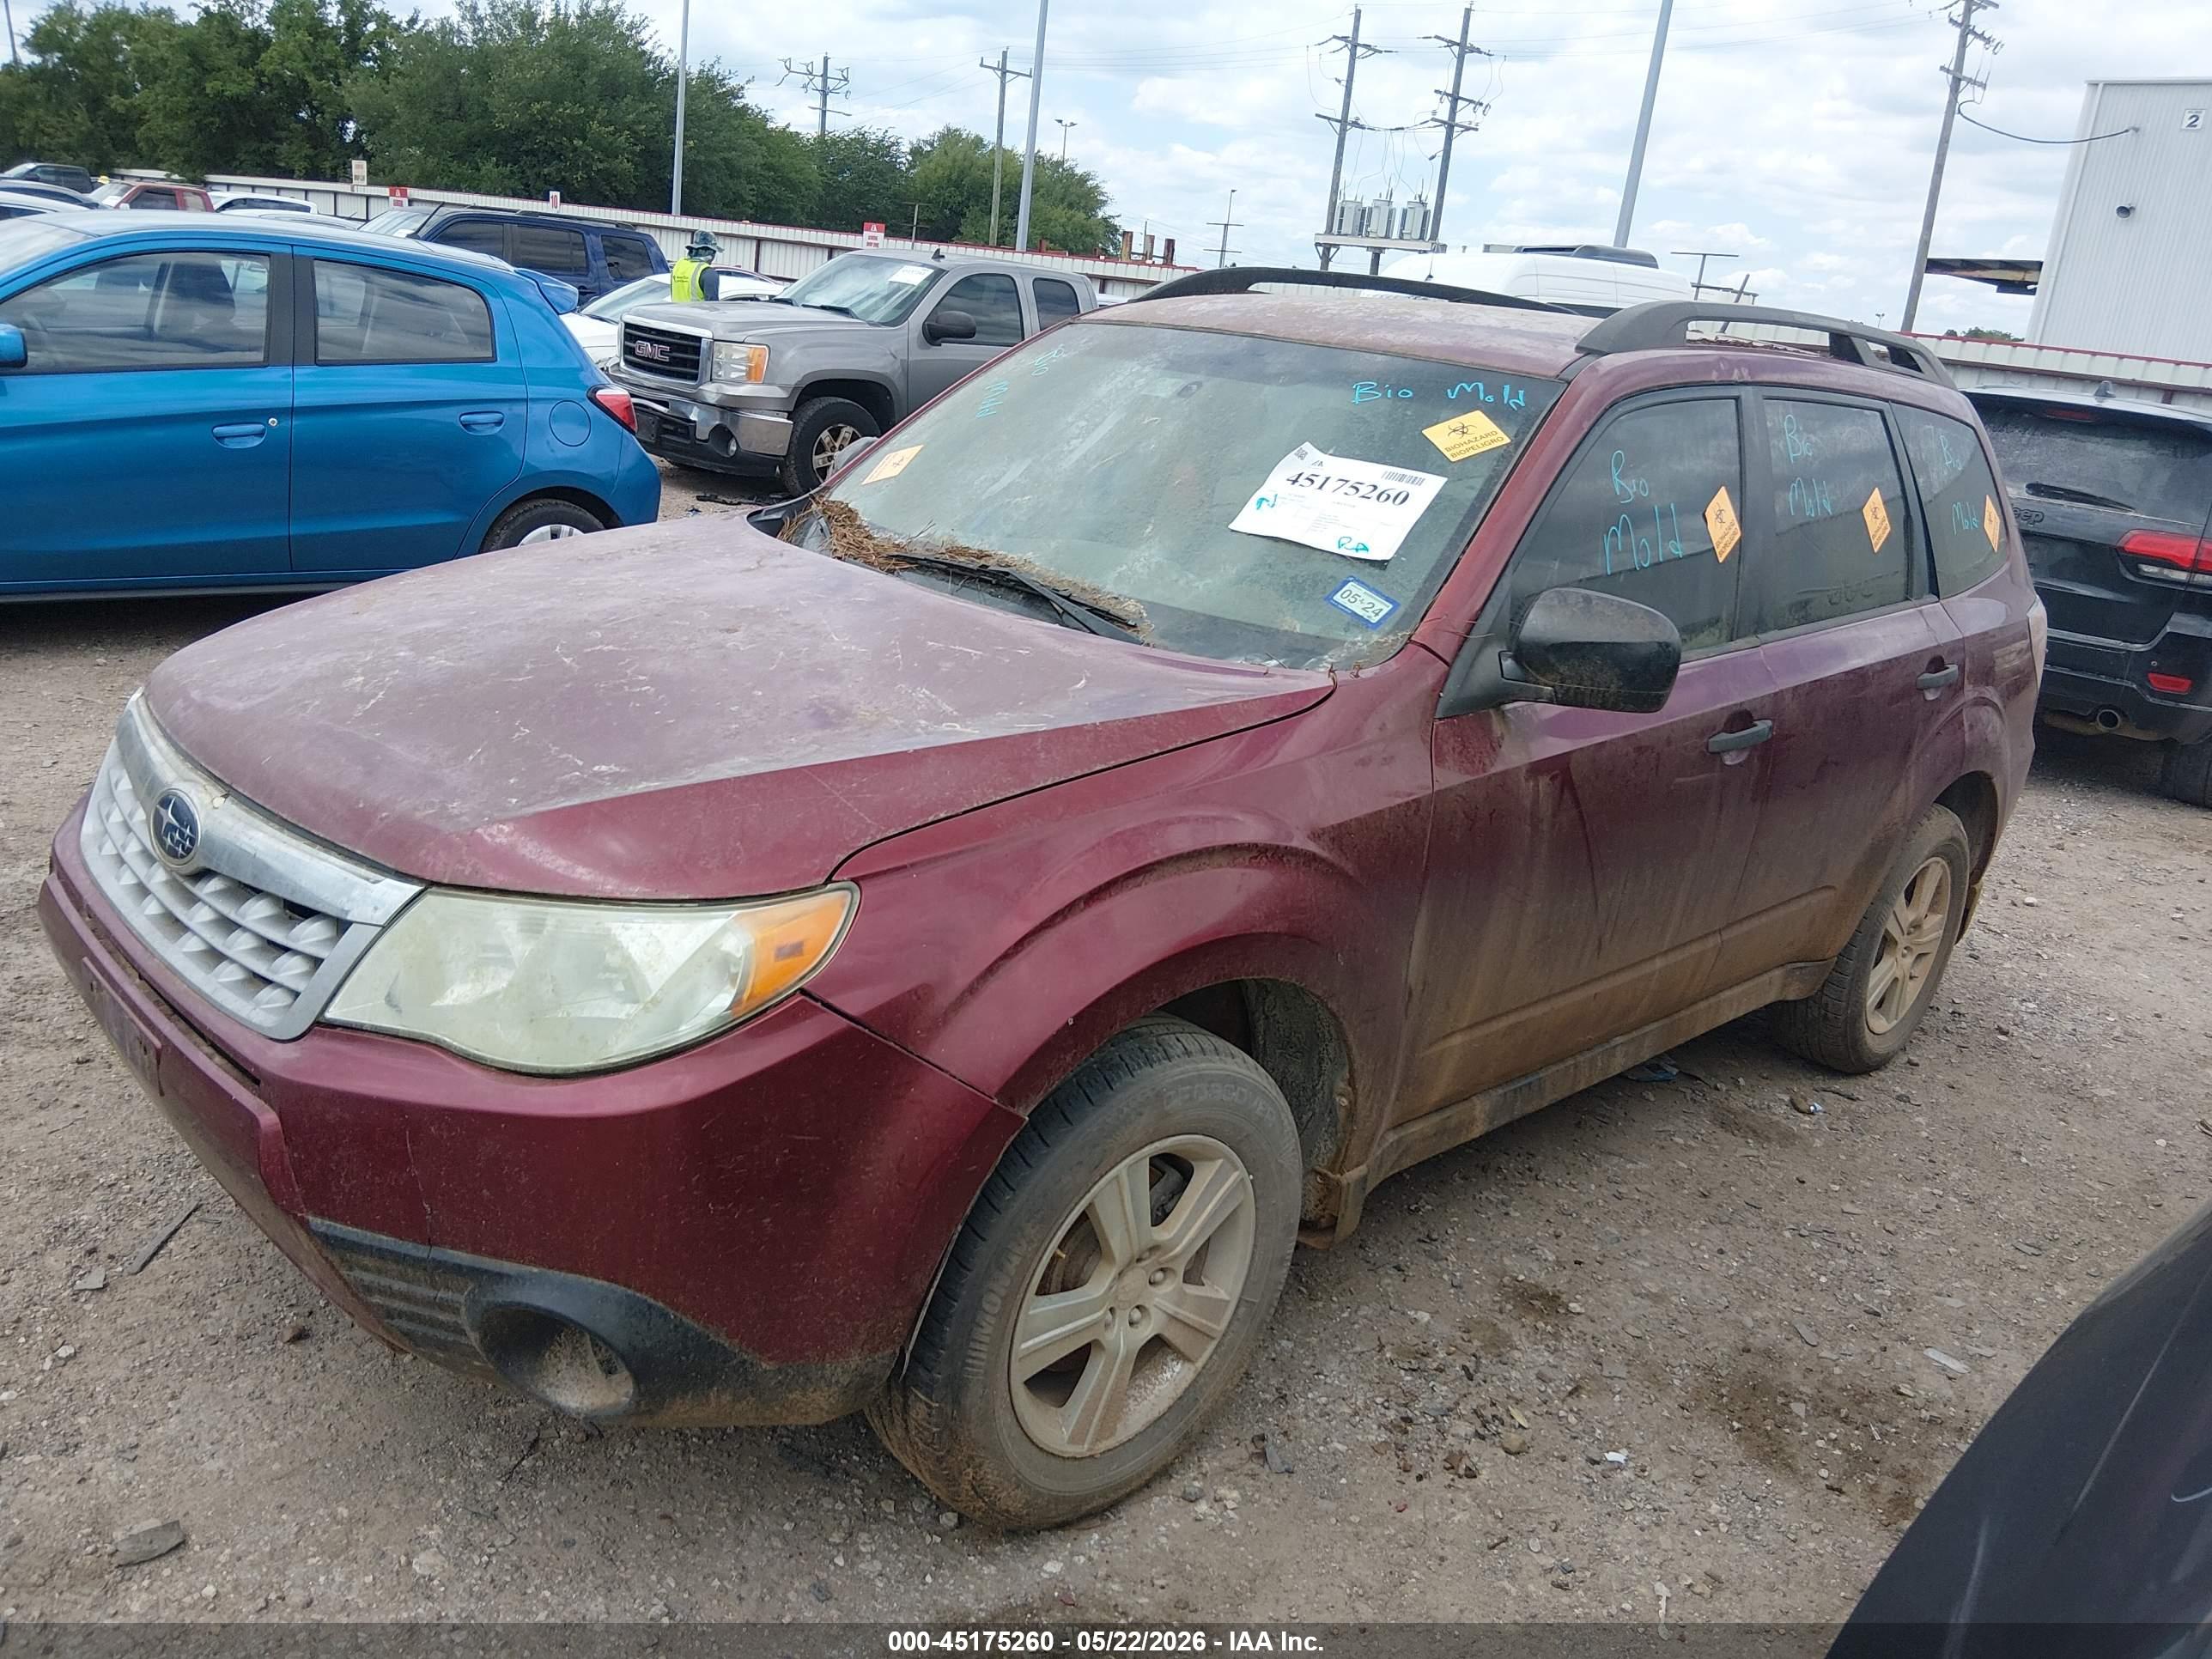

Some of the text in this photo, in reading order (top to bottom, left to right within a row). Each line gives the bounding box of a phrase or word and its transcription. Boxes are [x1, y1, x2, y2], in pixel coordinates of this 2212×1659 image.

[2185, 114, 2199, 129] 2
[550, 194, 558, 210] 10
[635, 340, 670, 362] GMC
[1352, 381, 1525, 410] Bio Mold
[1444, 430, 1498, 453] BIOHAZARD
[1450, 436, 1504, 459] BIOPELIGRO
[1286, 471, 1410, 506] 45175260
[2010, 507, 2045, 526] eep
[1603, 502, 1683, 575] Mold
[1362, 602, 1384, 617] 24
